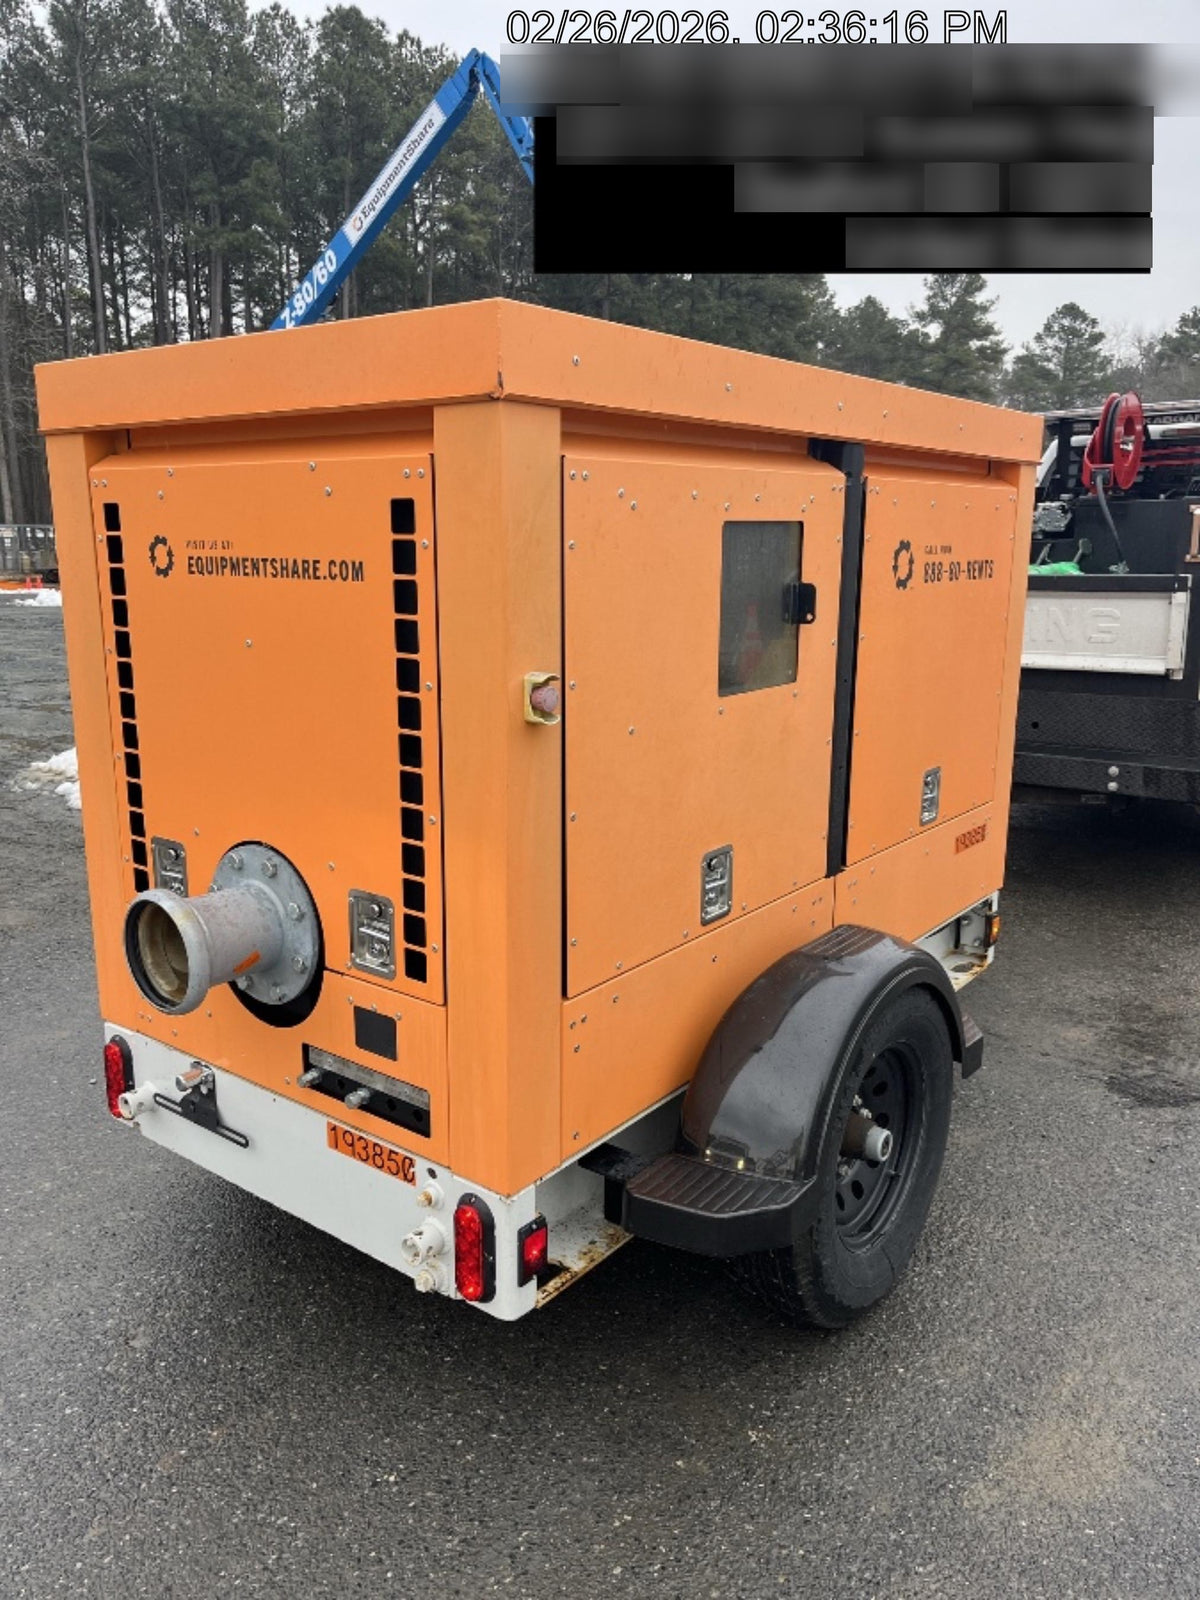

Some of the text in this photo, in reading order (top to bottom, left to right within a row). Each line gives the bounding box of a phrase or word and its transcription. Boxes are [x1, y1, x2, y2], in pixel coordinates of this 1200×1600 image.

[362, 118, 434, 219] EquipmentShare
[280, 249, 337, 329] Z-80/60
[187, 556, 364, 582] EQUIPMENTSHARE.COM
[924, 560, 993, 583] 888-80-RENTS
[330, 1125, 415, 1183] 193850
